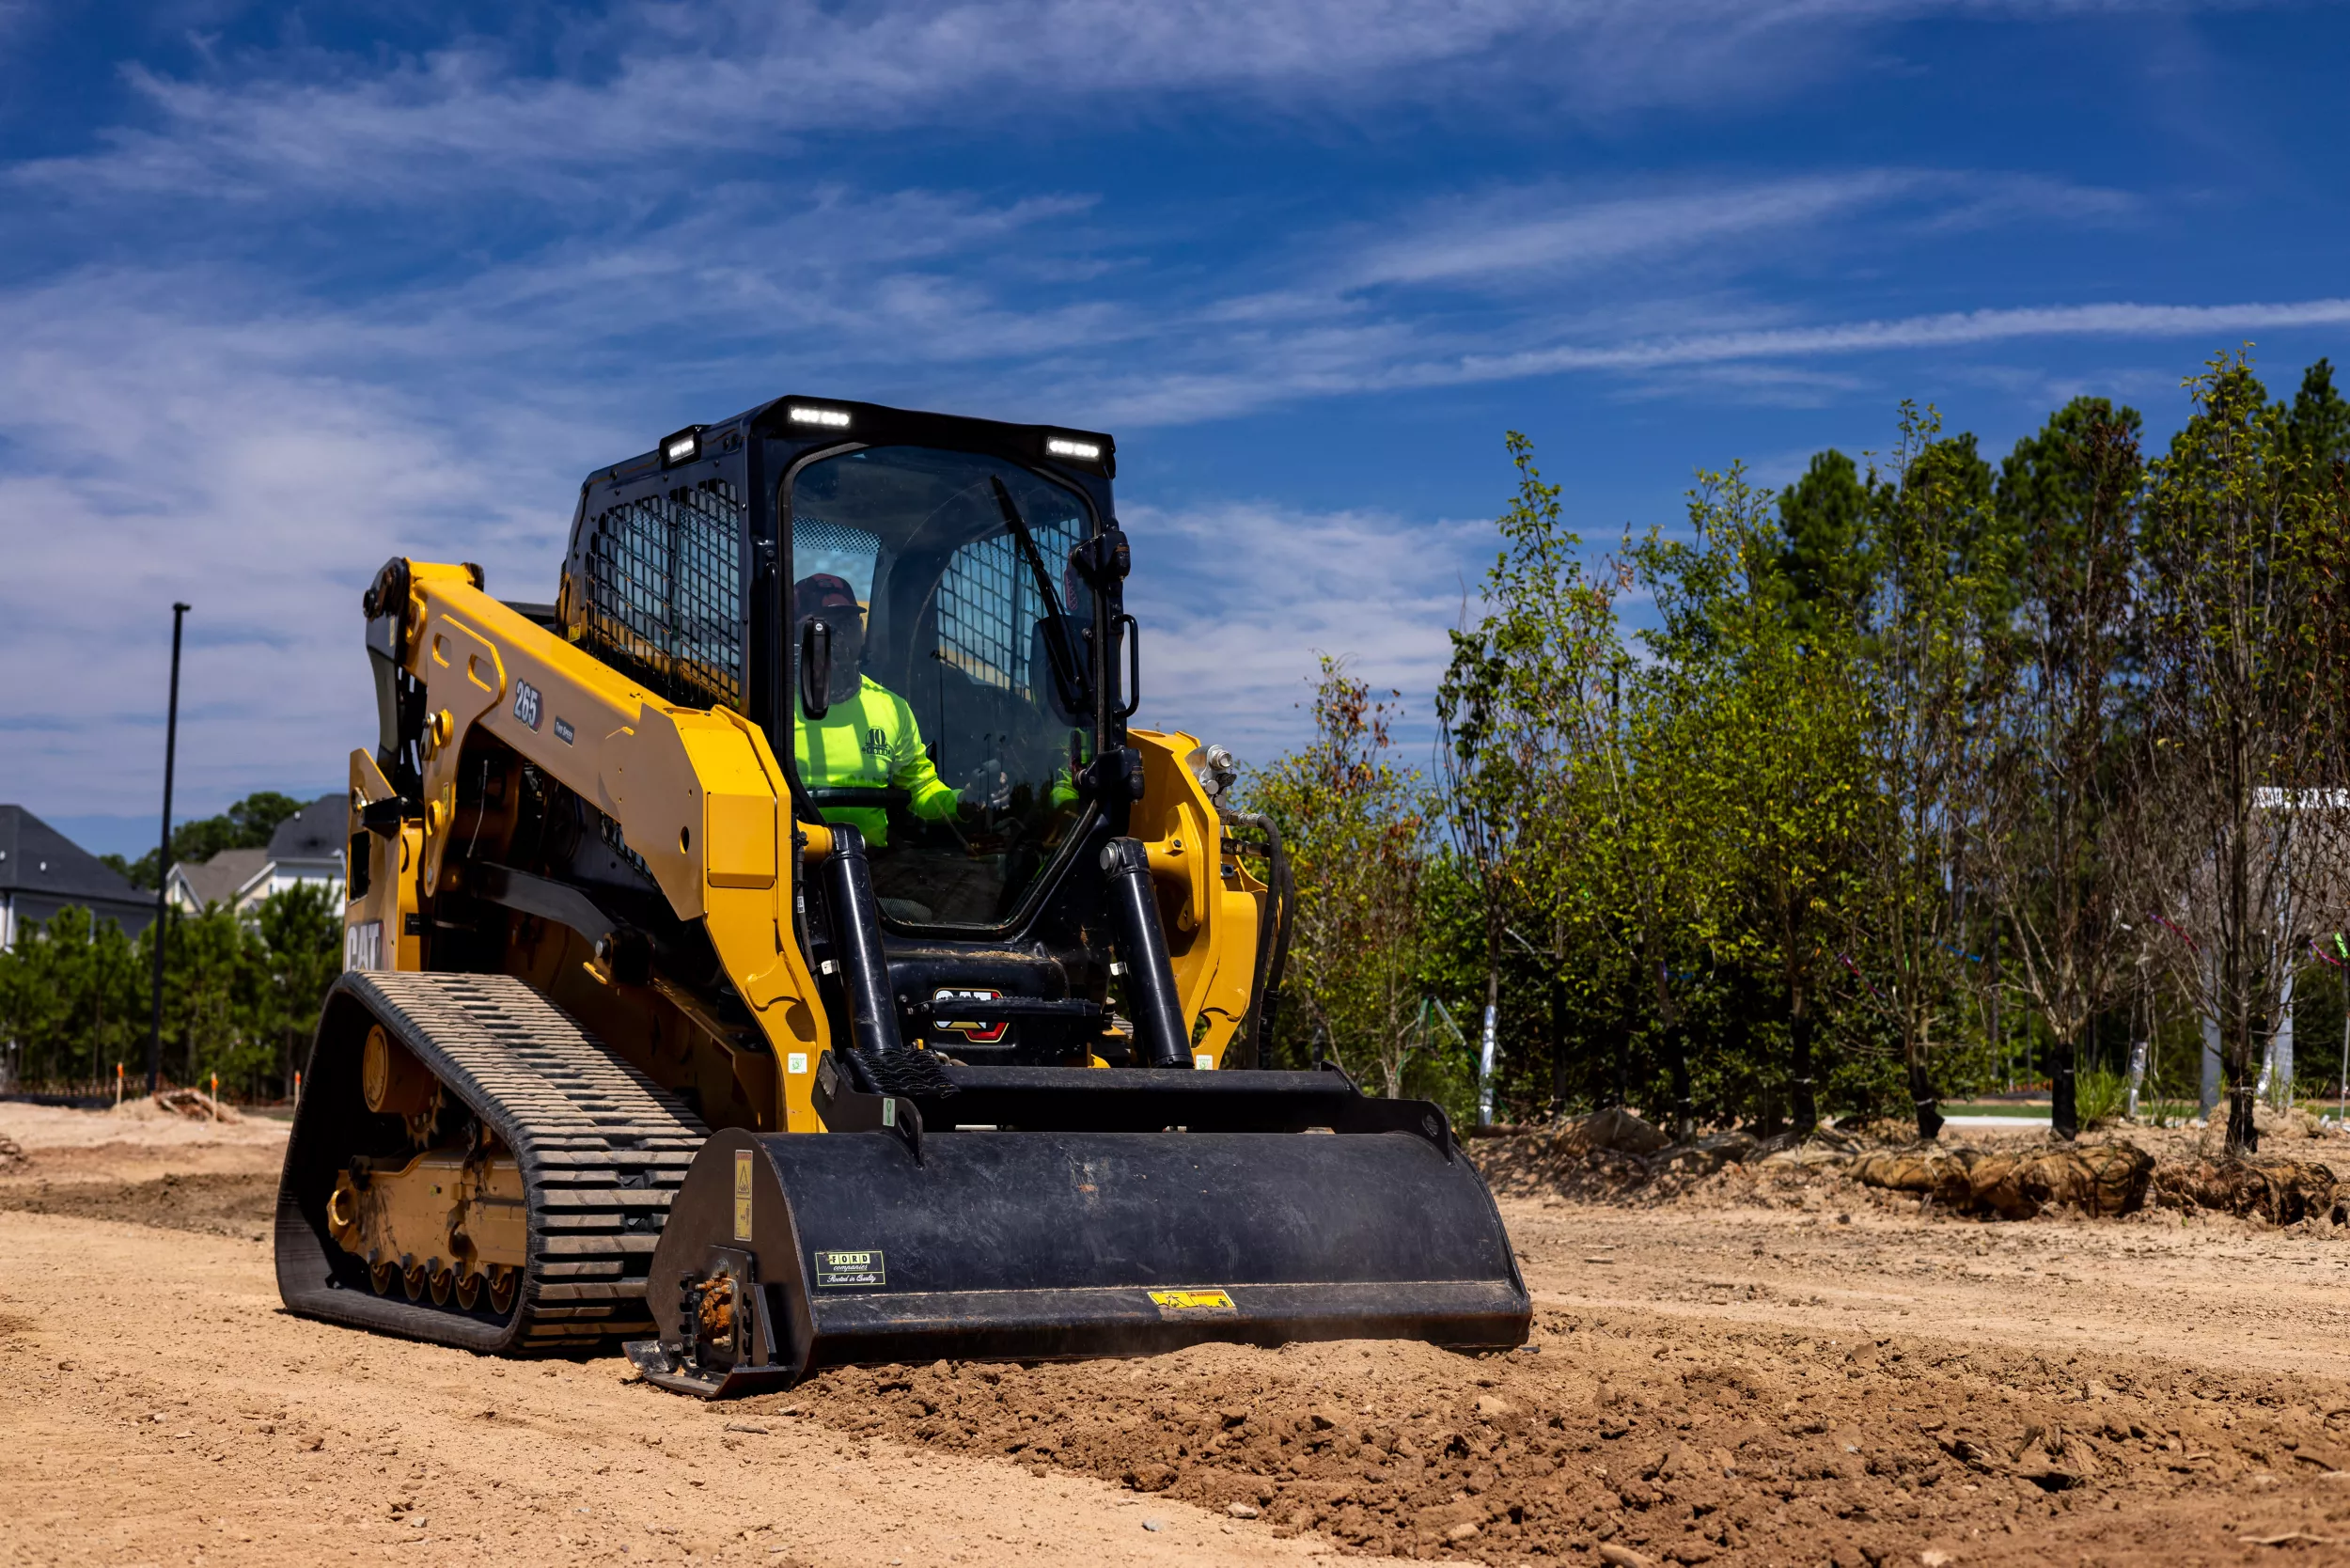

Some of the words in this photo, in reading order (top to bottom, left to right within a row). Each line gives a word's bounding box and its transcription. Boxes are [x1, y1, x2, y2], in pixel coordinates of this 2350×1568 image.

[514, 680, 538, 727] 265
[346, 923, 380, 971] CAT
[832, 1255, 868, 1263] FORD
